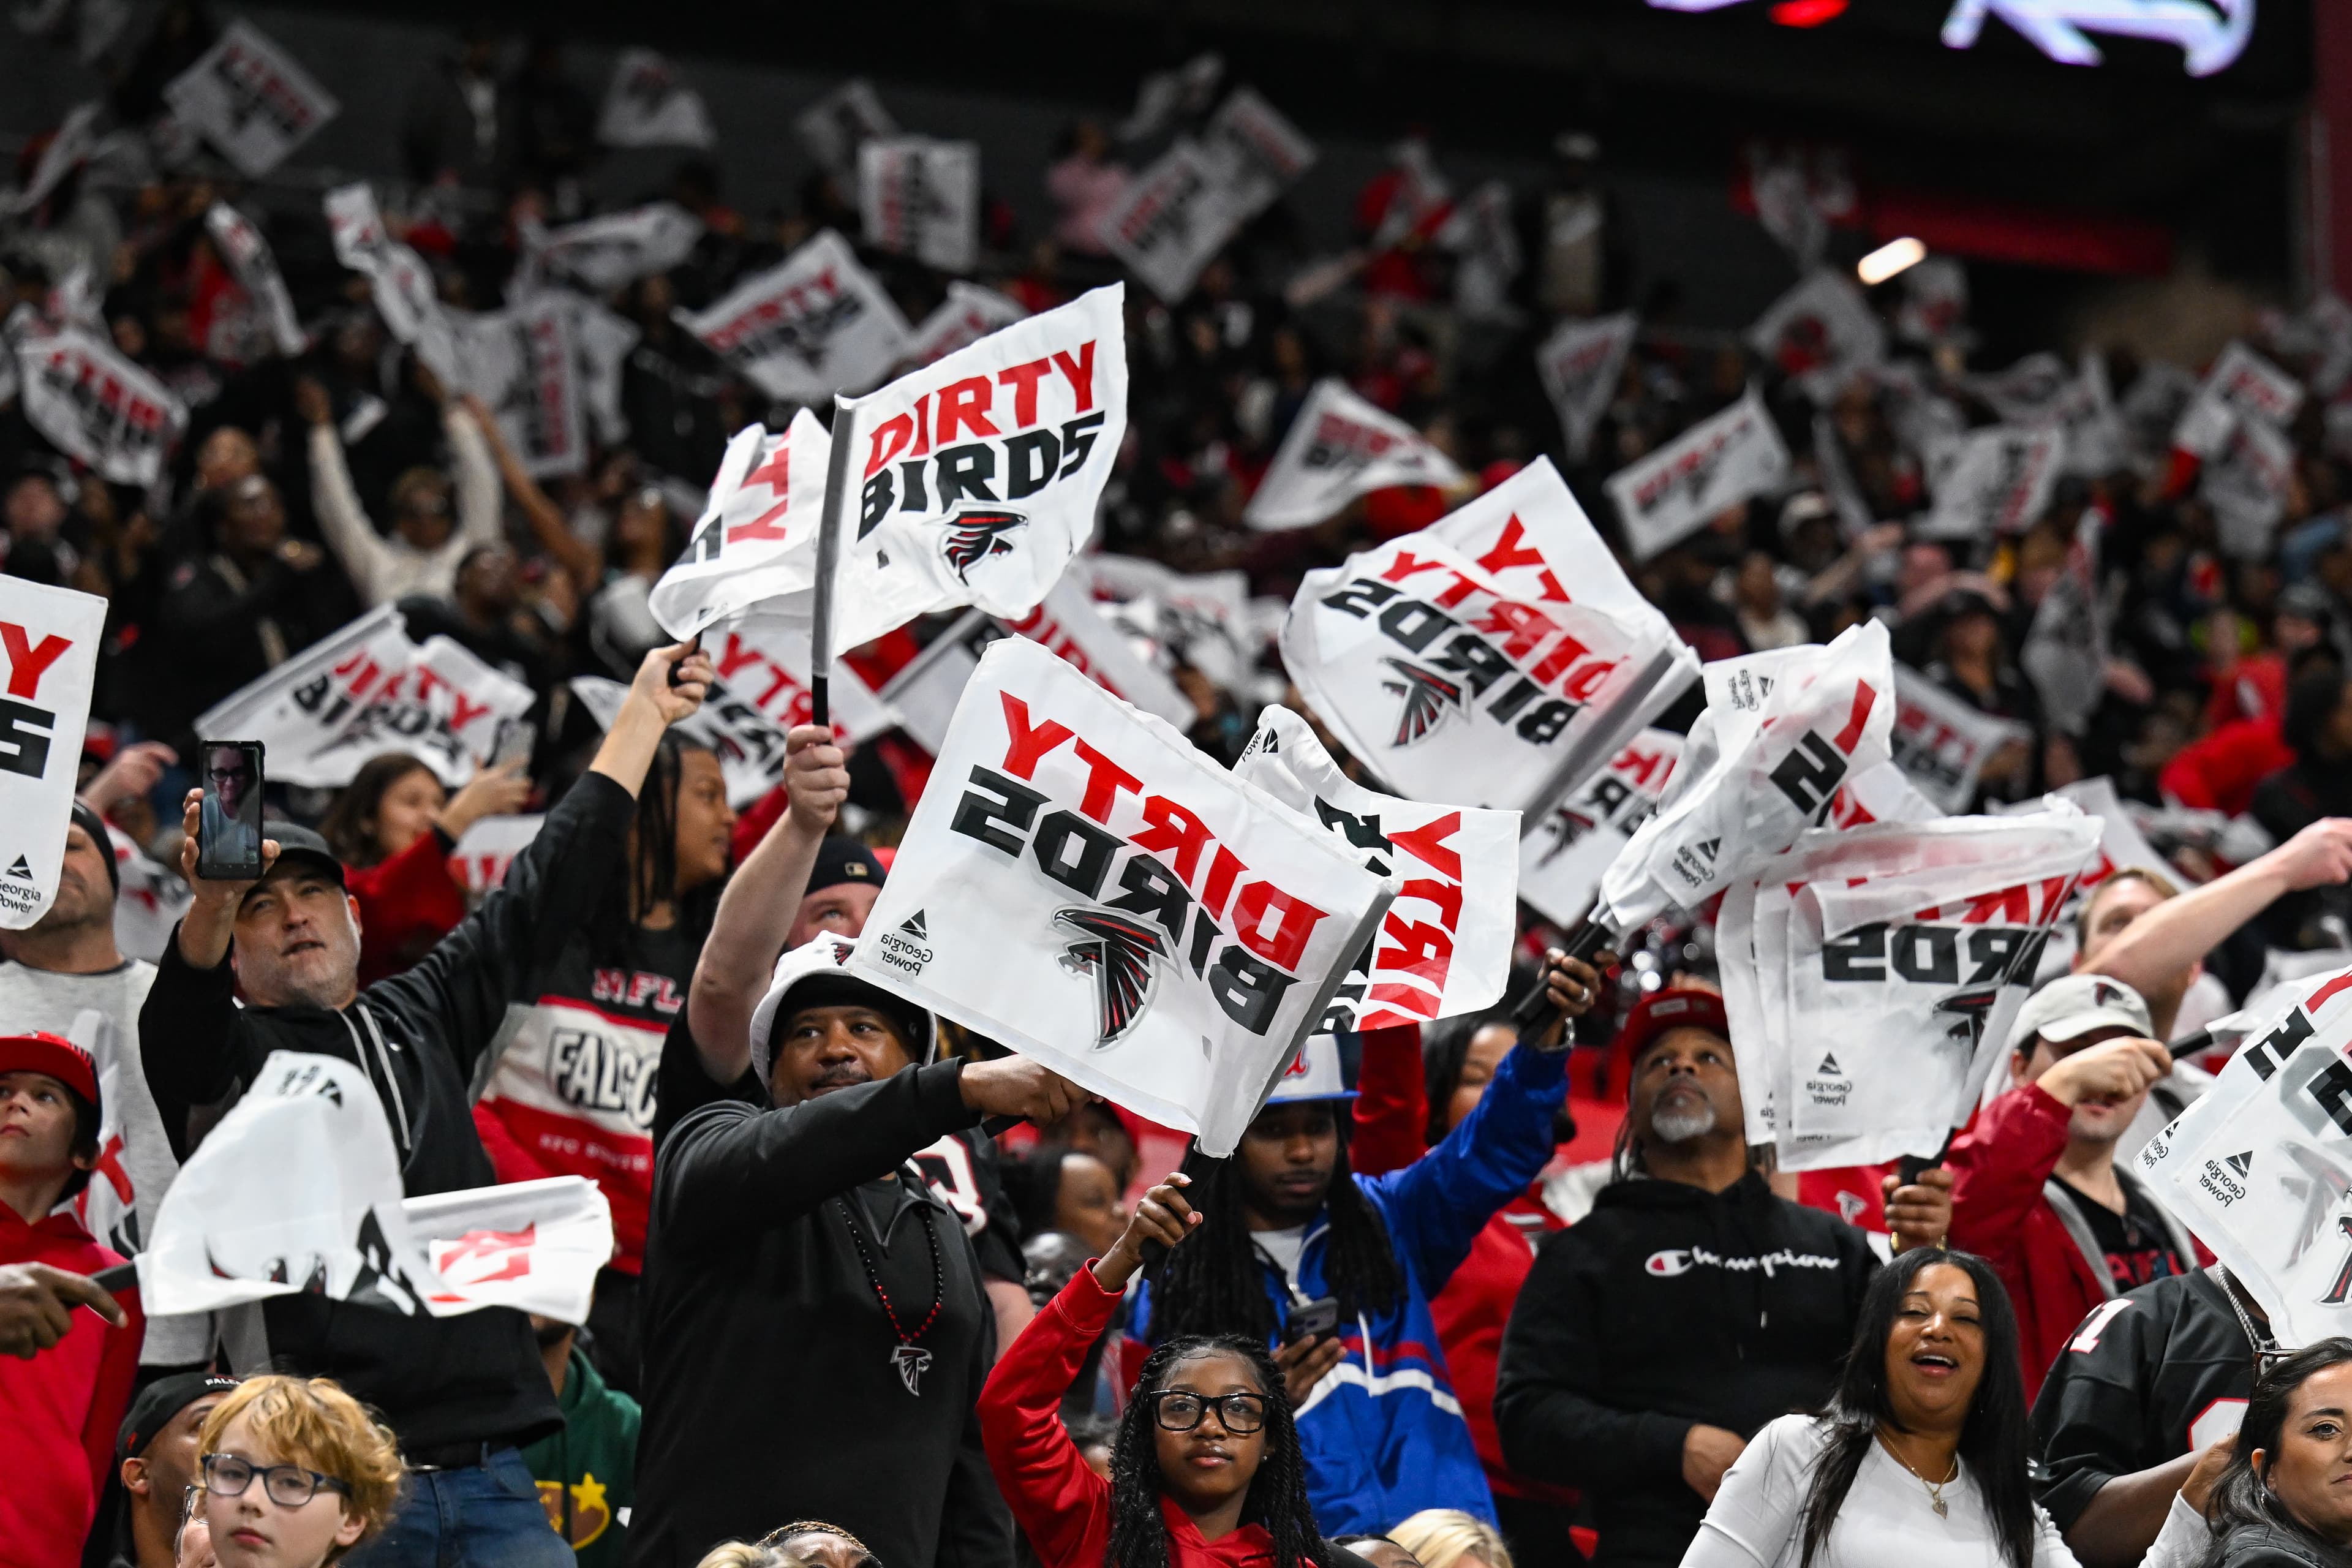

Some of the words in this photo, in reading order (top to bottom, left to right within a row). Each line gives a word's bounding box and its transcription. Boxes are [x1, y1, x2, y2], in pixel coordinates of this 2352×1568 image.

[864, 339, 1096, 483] DIRTY
[857, 410, 1105, 544] BIRDS
[592, 968, 685, 1014] NFL
[1645, 1245, 1841, 1278] Champion
